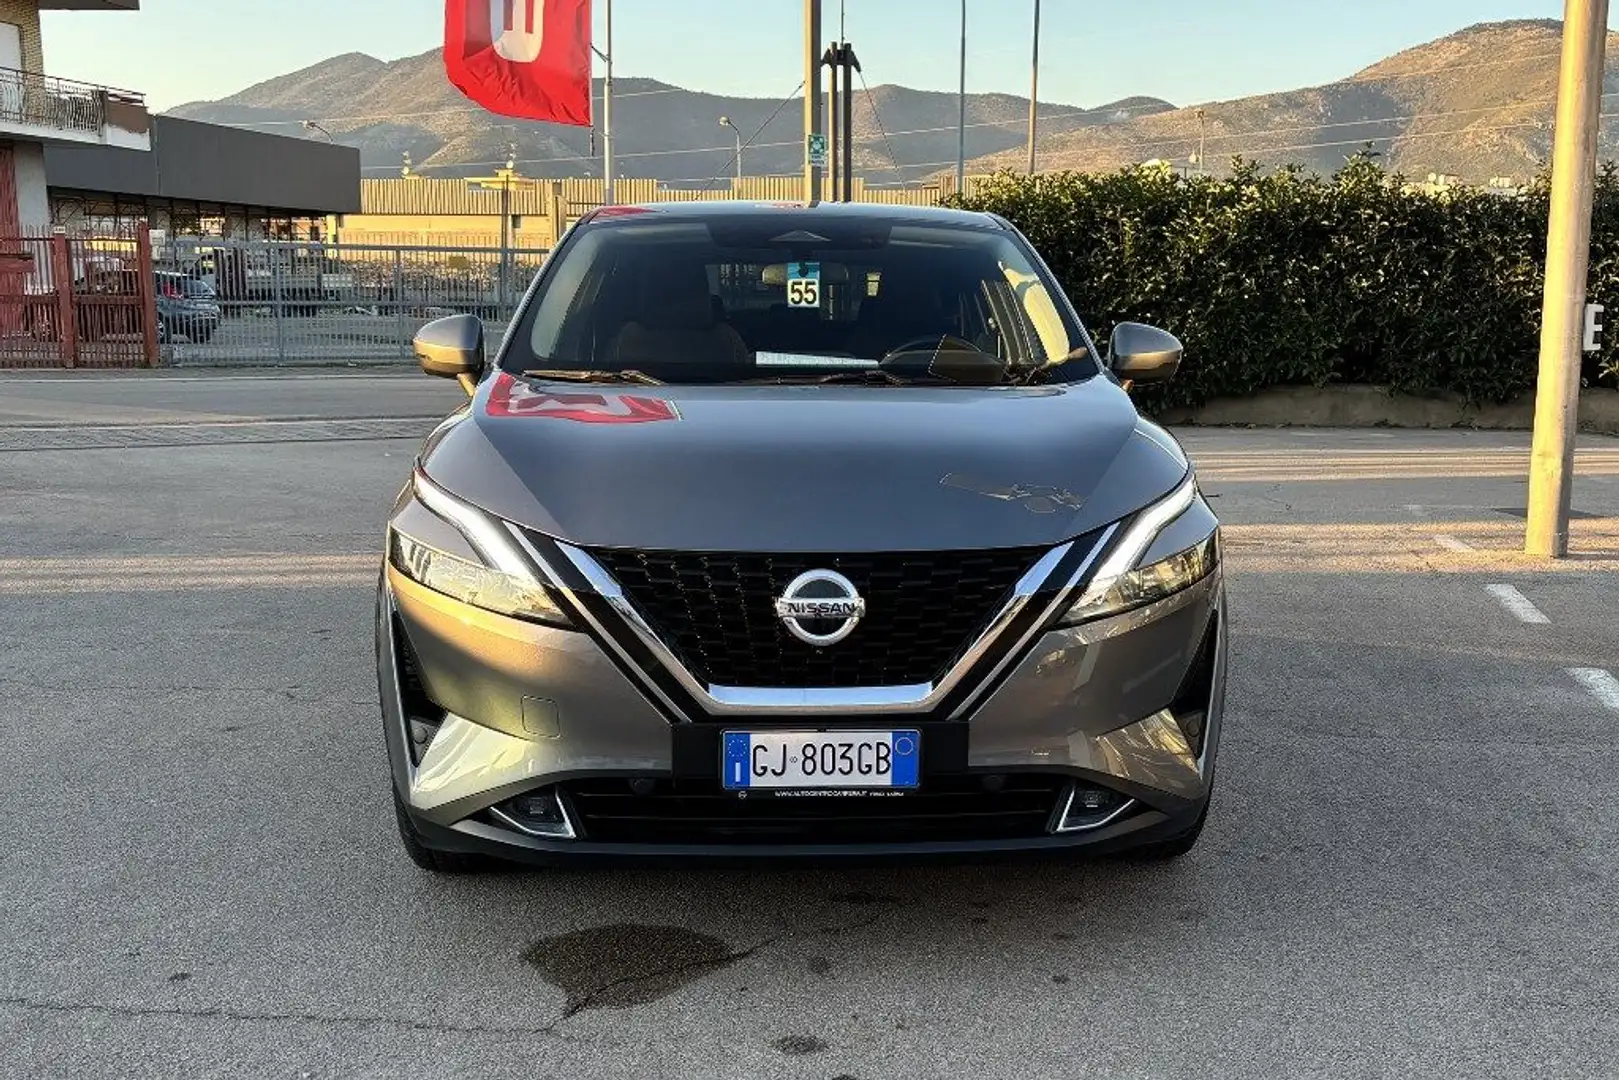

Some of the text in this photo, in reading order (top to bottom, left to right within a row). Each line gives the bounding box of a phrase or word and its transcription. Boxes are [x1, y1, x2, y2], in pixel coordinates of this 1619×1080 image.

[790, 281, 817, 304] 55
[787, 602, 858, 613] NISSAN
[752, 741, 892, 777] GJ 803GB
